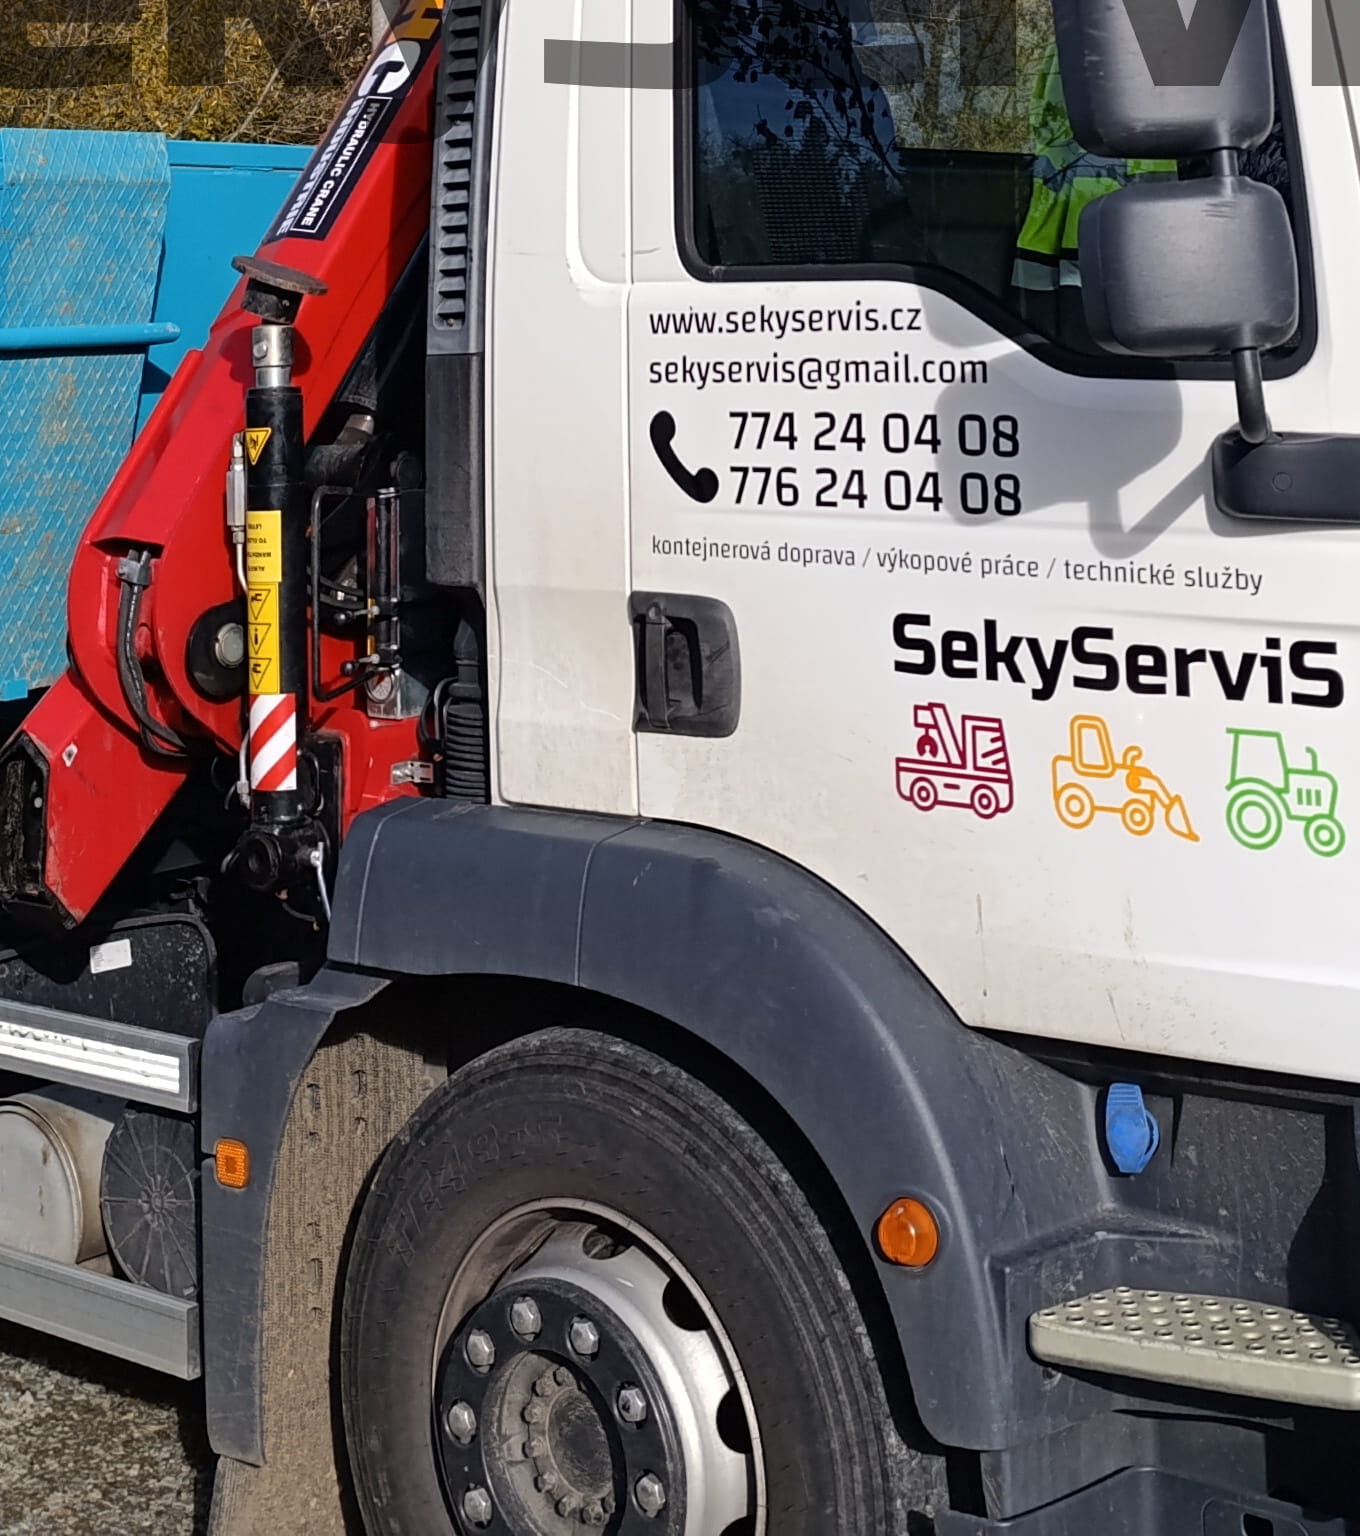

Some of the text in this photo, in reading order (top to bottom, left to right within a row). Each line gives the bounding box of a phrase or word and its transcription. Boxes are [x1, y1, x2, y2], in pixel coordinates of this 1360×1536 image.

[276, 97, 365, 236] INDUSTRIE
[300, 102, 381, 226] HYDRAULIC CRANE
[649, 300, 923, 339] www.sekyservis.cz
[649, 352, 989, 390] sekyservis@gmail.com
[728, 411, 1020, 458] 774 24 04 08
[729, 466, 1023, 516] 776 24 04 08
[652, 535, 1264, 596] kontejnerová doprava / výkopové práce / technické služby
[892, 612, 1345, 709] SekyServiS
